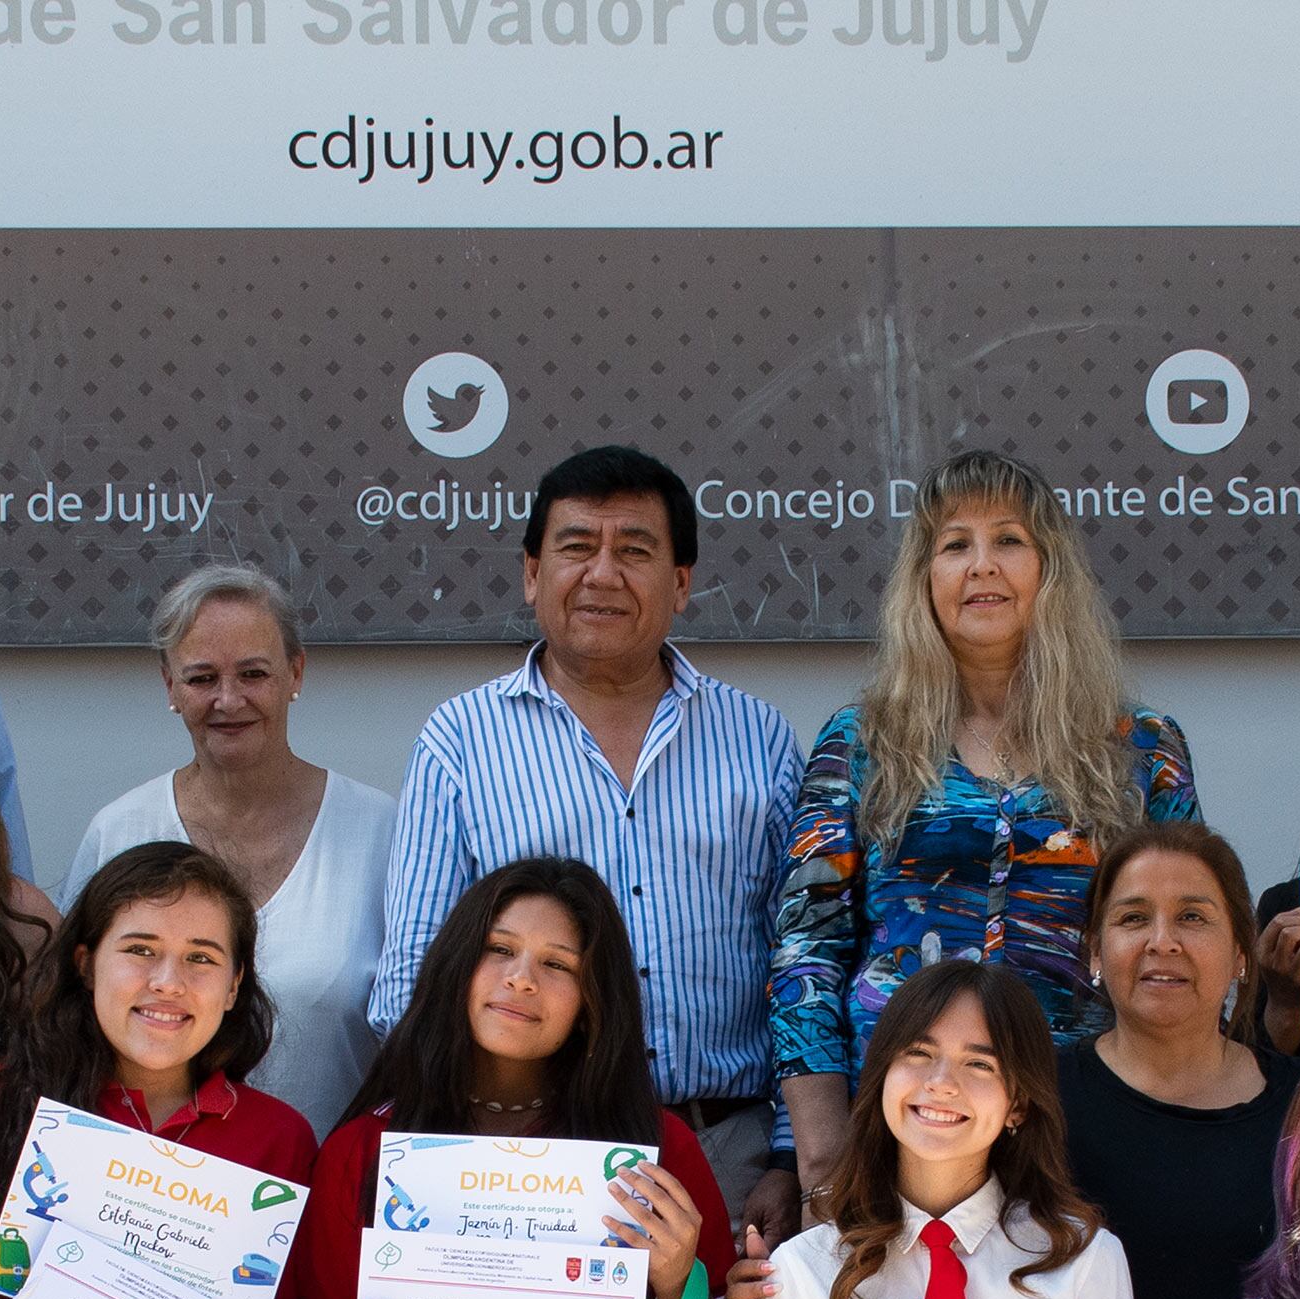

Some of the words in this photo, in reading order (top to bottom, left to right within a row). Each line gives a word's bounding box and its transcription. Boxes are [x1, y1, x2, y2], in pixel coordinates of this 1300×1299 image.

[112, 0, 266, 45] San
[302, 0, 684, 46] Salvador
[713, 0, 809, 46] de
[832, 0, 1048, 62] Jujuy
[287, 114, 723, 184] cdjujuy.gob.ar
[27, 482, 83, 523] de
[95, 482, 215, 533] Jujuy
[355, 480, 537, 530] @cdjuju
[694, 480, 876, 529] Concejo
[1158, 476, 1213, 516] de
[106, 1159, 229, 1218] DIPLOMA
[460, 1171, 585, 1195] DIPLOMA
[99, 1204, 154, 1231] Estefanía
[156, 1223, 211, 1251] Gabriela
[105, 1190, 123, 1201] Este
[124, 1196, 167, 1217] certificado
[169, 1212, 178, 1220] se
[179, 1216, 206, 1231] otorga
[456, 1215, 501, 1236] Jazmín
[525, 1218, 578, 1241] Trinidad
[482, 1203, 525, 1211] certificado
[538, 1206, 565, 1214] otorga
